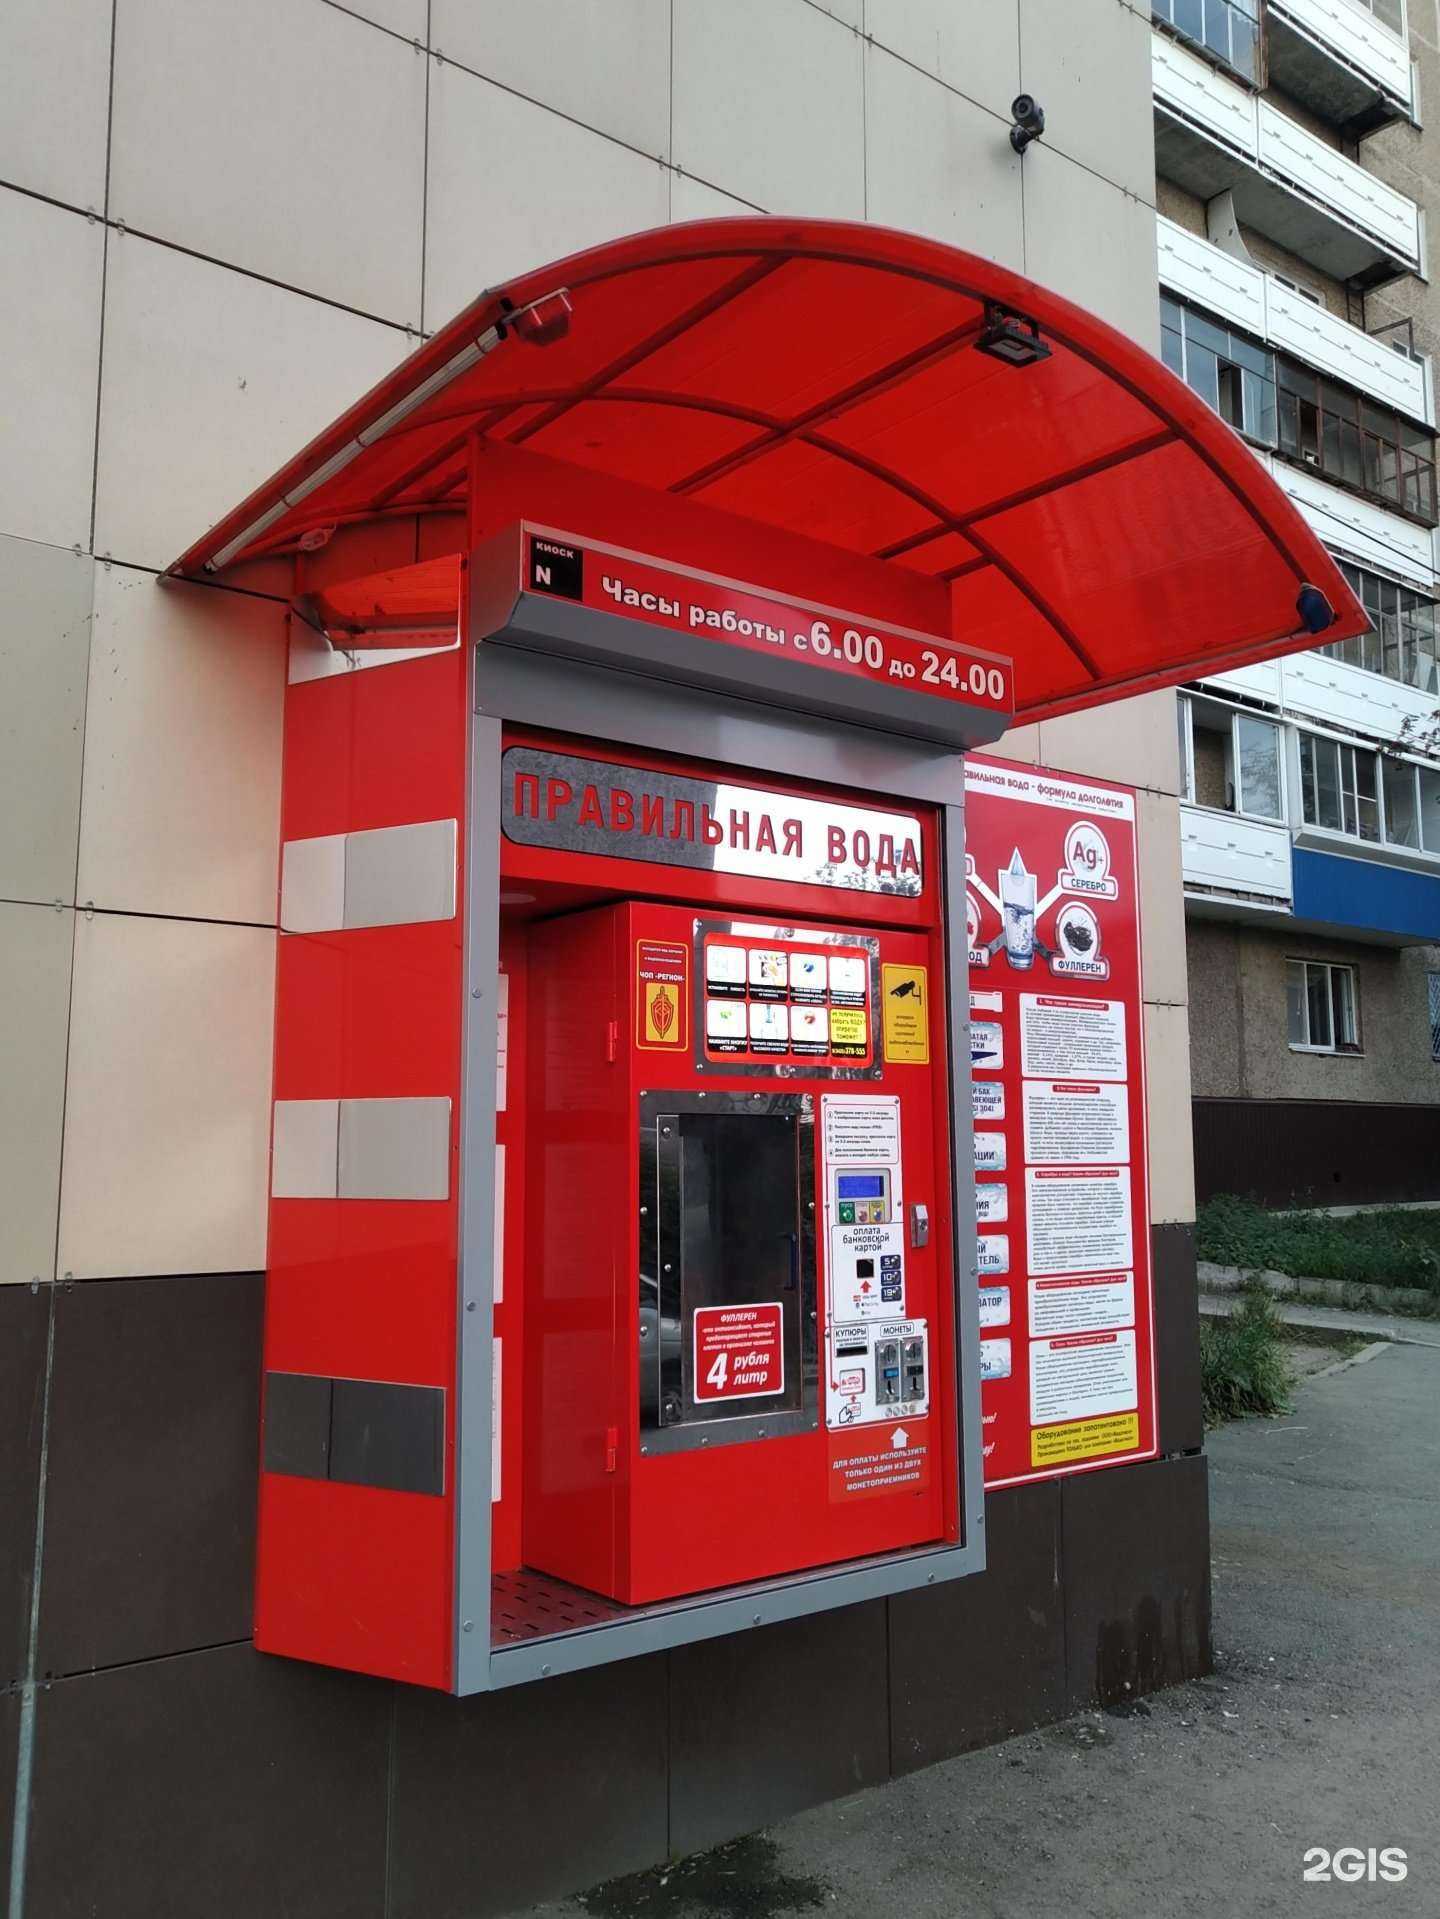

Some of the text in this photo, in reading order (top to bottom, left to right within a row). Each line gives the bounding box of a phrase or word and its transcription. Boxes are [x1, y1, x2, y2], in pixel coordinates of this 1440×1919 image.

[536, 564, 551, 585] N
[602, 576, 680, 618] Часы
[689, 605, 785, 645] работы
[810, 621, 884, 669] 6.00
[889, 659, 916, 678] до
[921, 651, 1004, 700] 24.00
[964, 769, 1006, 786] авильная
[1037, 783, 1077, 800] формула
[1077, 793, 1124, 809] долголетия
[513, 772, 920, 879] ПРАВИЛЬНАЯ ВОДА
[1071, 878, 1107, 892] СЕРЕБРО
[1058, 960, 1102, 973] ФУЛЛЕРЕН
[843, 1234, 890, 1244] банковской
[853, 1227, 881, 1237] оплата
[854, 1243, 882, 1253] картой
[836, 1328, 866, 1337] КУПЮРЫ
[883, 1325, 911, 1334] МОНЕТЫ
[706, 1351, 770, 1390] 4 рубля
[733, 1371, 768, 1385] литр
[833, 1460, 848, 1469] ДЛЯ
[849, 1455, 879, 1465] ОПЛАТЫ
[845, 1468, 872, 1478] ТОЛЬКО
[874, 1463, 893, 1474] ОДИН
[904, 1459, 921, 1469] ДВУХ
